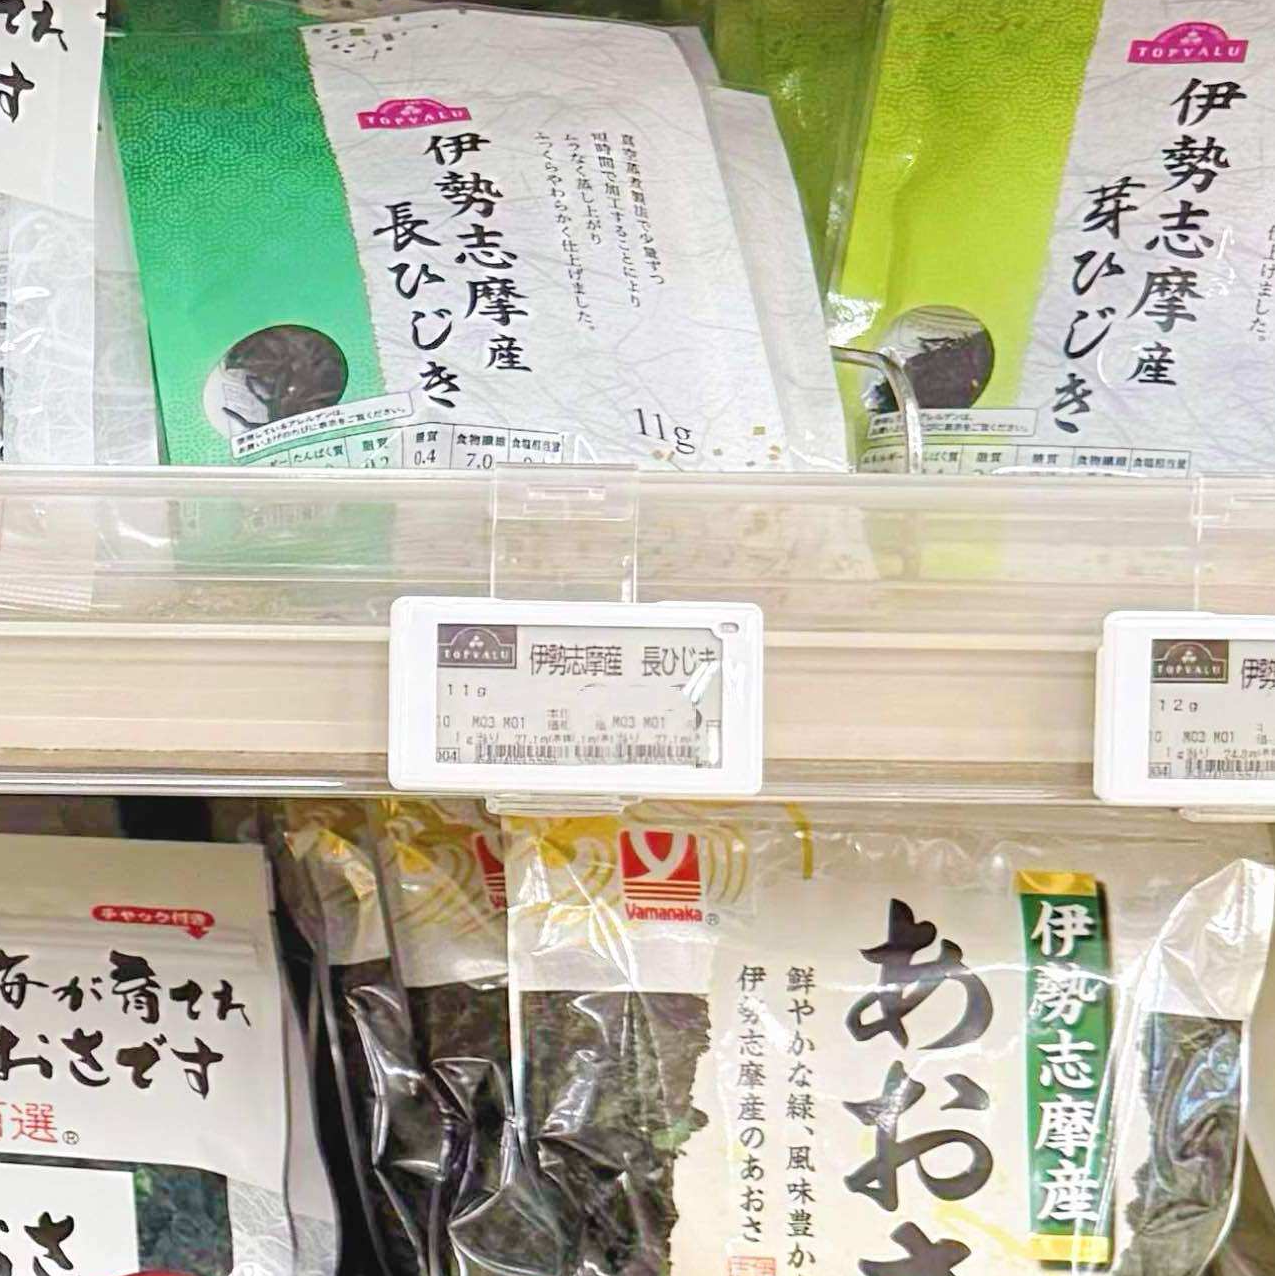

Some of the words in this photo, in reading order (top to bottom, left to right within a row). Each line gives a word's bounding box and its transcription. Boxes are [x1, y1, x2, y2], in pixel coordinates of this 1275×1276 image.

[1137, 44, 1242, 62] TOPVALU
[364, 108, 465, 128] TOPVALU
[1127, 77, 1248, 387] 伊勢志摩産
[425, 133, 533, 373] 伊勢志摩産
[372, 201, 462, 411] 長ひじき
[1052, 175, 1147, 434] 芽ひじき
[634, 407, 695, 456] 11g
[466, 452, 493, 470] 7.0
[443, 648, 509, 661] TOPVALU
[530, 643, 623, 677] 伊勢志摩産
[448, 684, 487, 699] 11g
[1159, 698, 1198, 712] 12g
[625, 903, 703, 924] Yamanaka
[1029, 899, 1101, 1225] 伊勢志摩産
[735, 963, 769, 1246] 伊勢志摩産のあおさ
